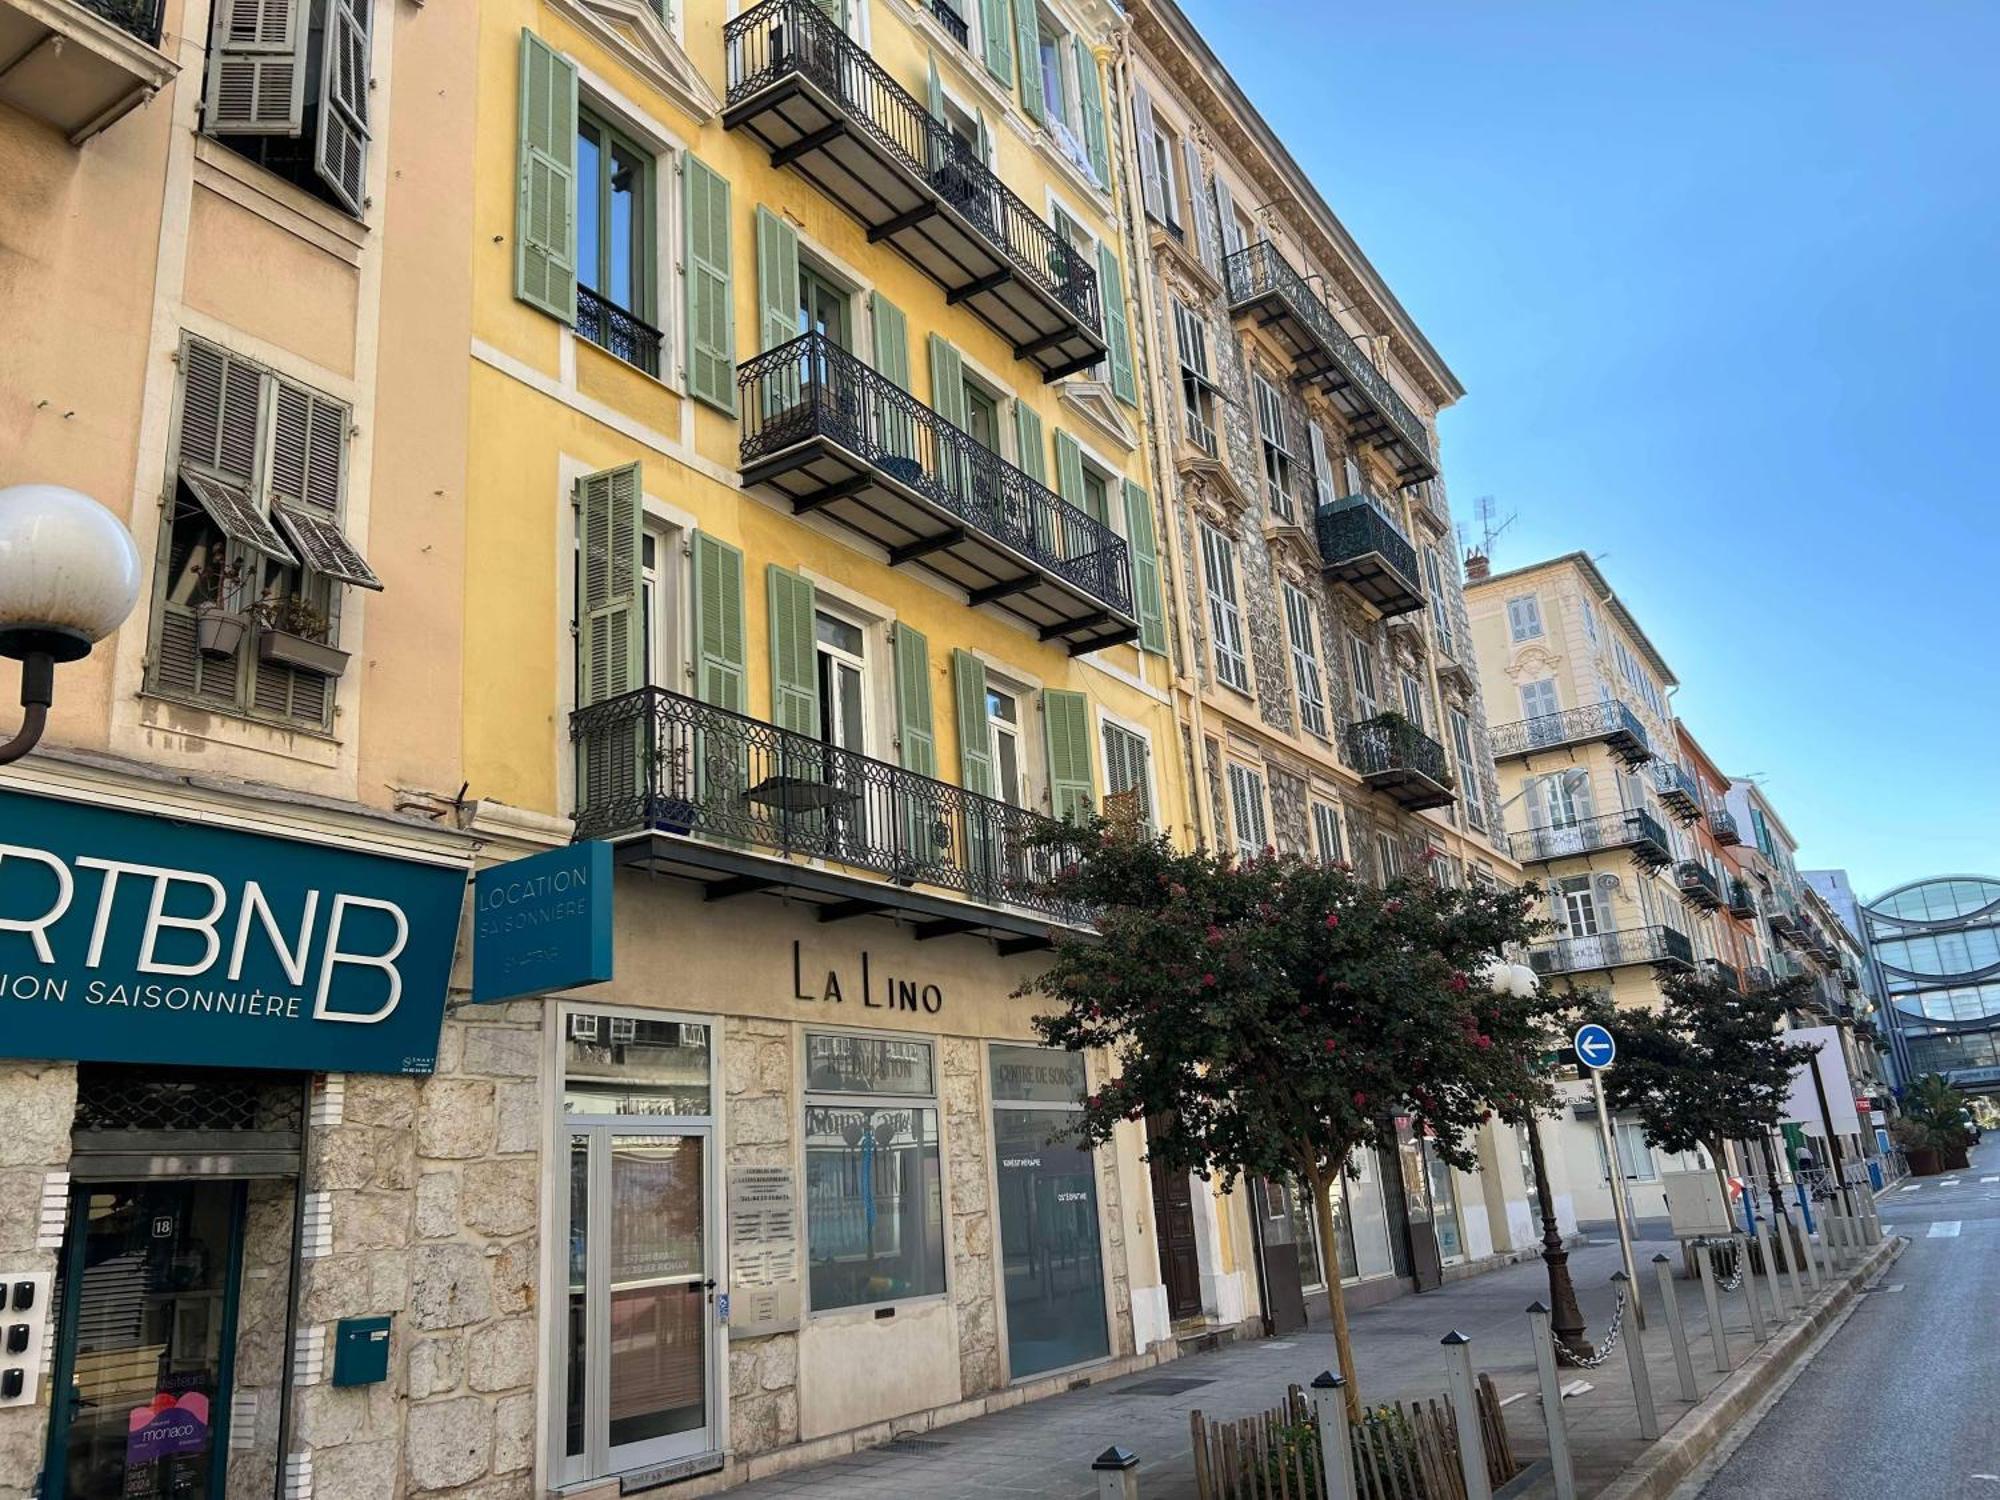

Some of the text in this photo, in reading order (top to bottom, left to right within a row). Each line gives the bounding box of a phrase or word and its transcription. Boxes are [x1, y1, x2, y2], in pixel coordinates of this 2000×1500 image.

[480, 866, 587, 912] LOCATION
[85, 981, 302, 1018] SAISONNIÈRE
[1035, 1065, 1048, 1084] DE
[156, 1220, 170, 1233] 18
[142, 1424, 194, 1442] monaco
